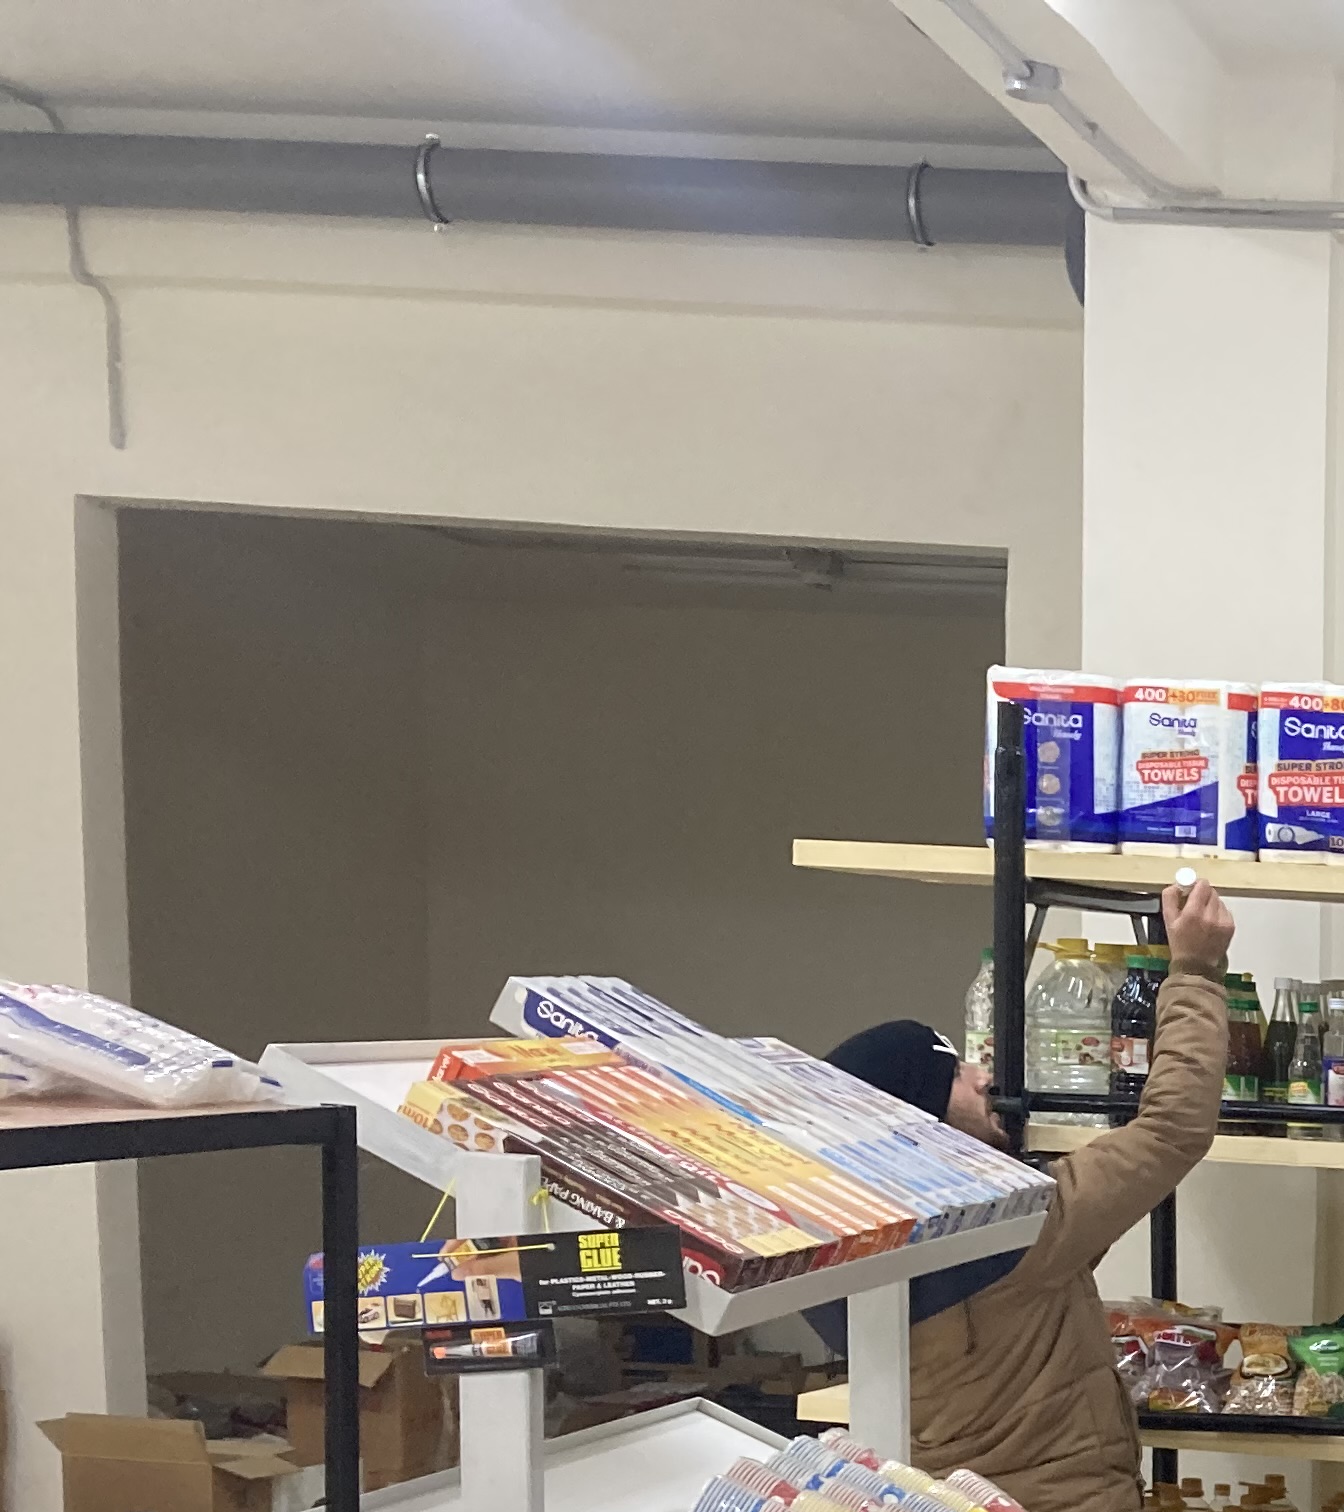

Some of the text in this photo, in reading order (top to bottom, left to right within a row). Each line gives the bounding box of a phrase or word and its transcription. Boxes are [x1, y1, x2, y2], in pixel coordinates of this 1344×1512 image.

[1135, 688, 1166, 701] 400
[1289, 695, 1323, 710] 400
[1023, 708, 1083, 729] Sanita
[1149, 712, 1198, 728] Sanita
[1142, 768, 1199, 782] TOWELS
[1276, 762, 1312, 772] SUPER
[1271, 776, 1331, 786] DISPOSABLE
[536, 1000, 600, 1042] Sanita
[570, 1194, 614, 1225] BAKING
[578, 1233, 619, 1249] SUPER
[580, 1248, 622, 1268] GLUE
